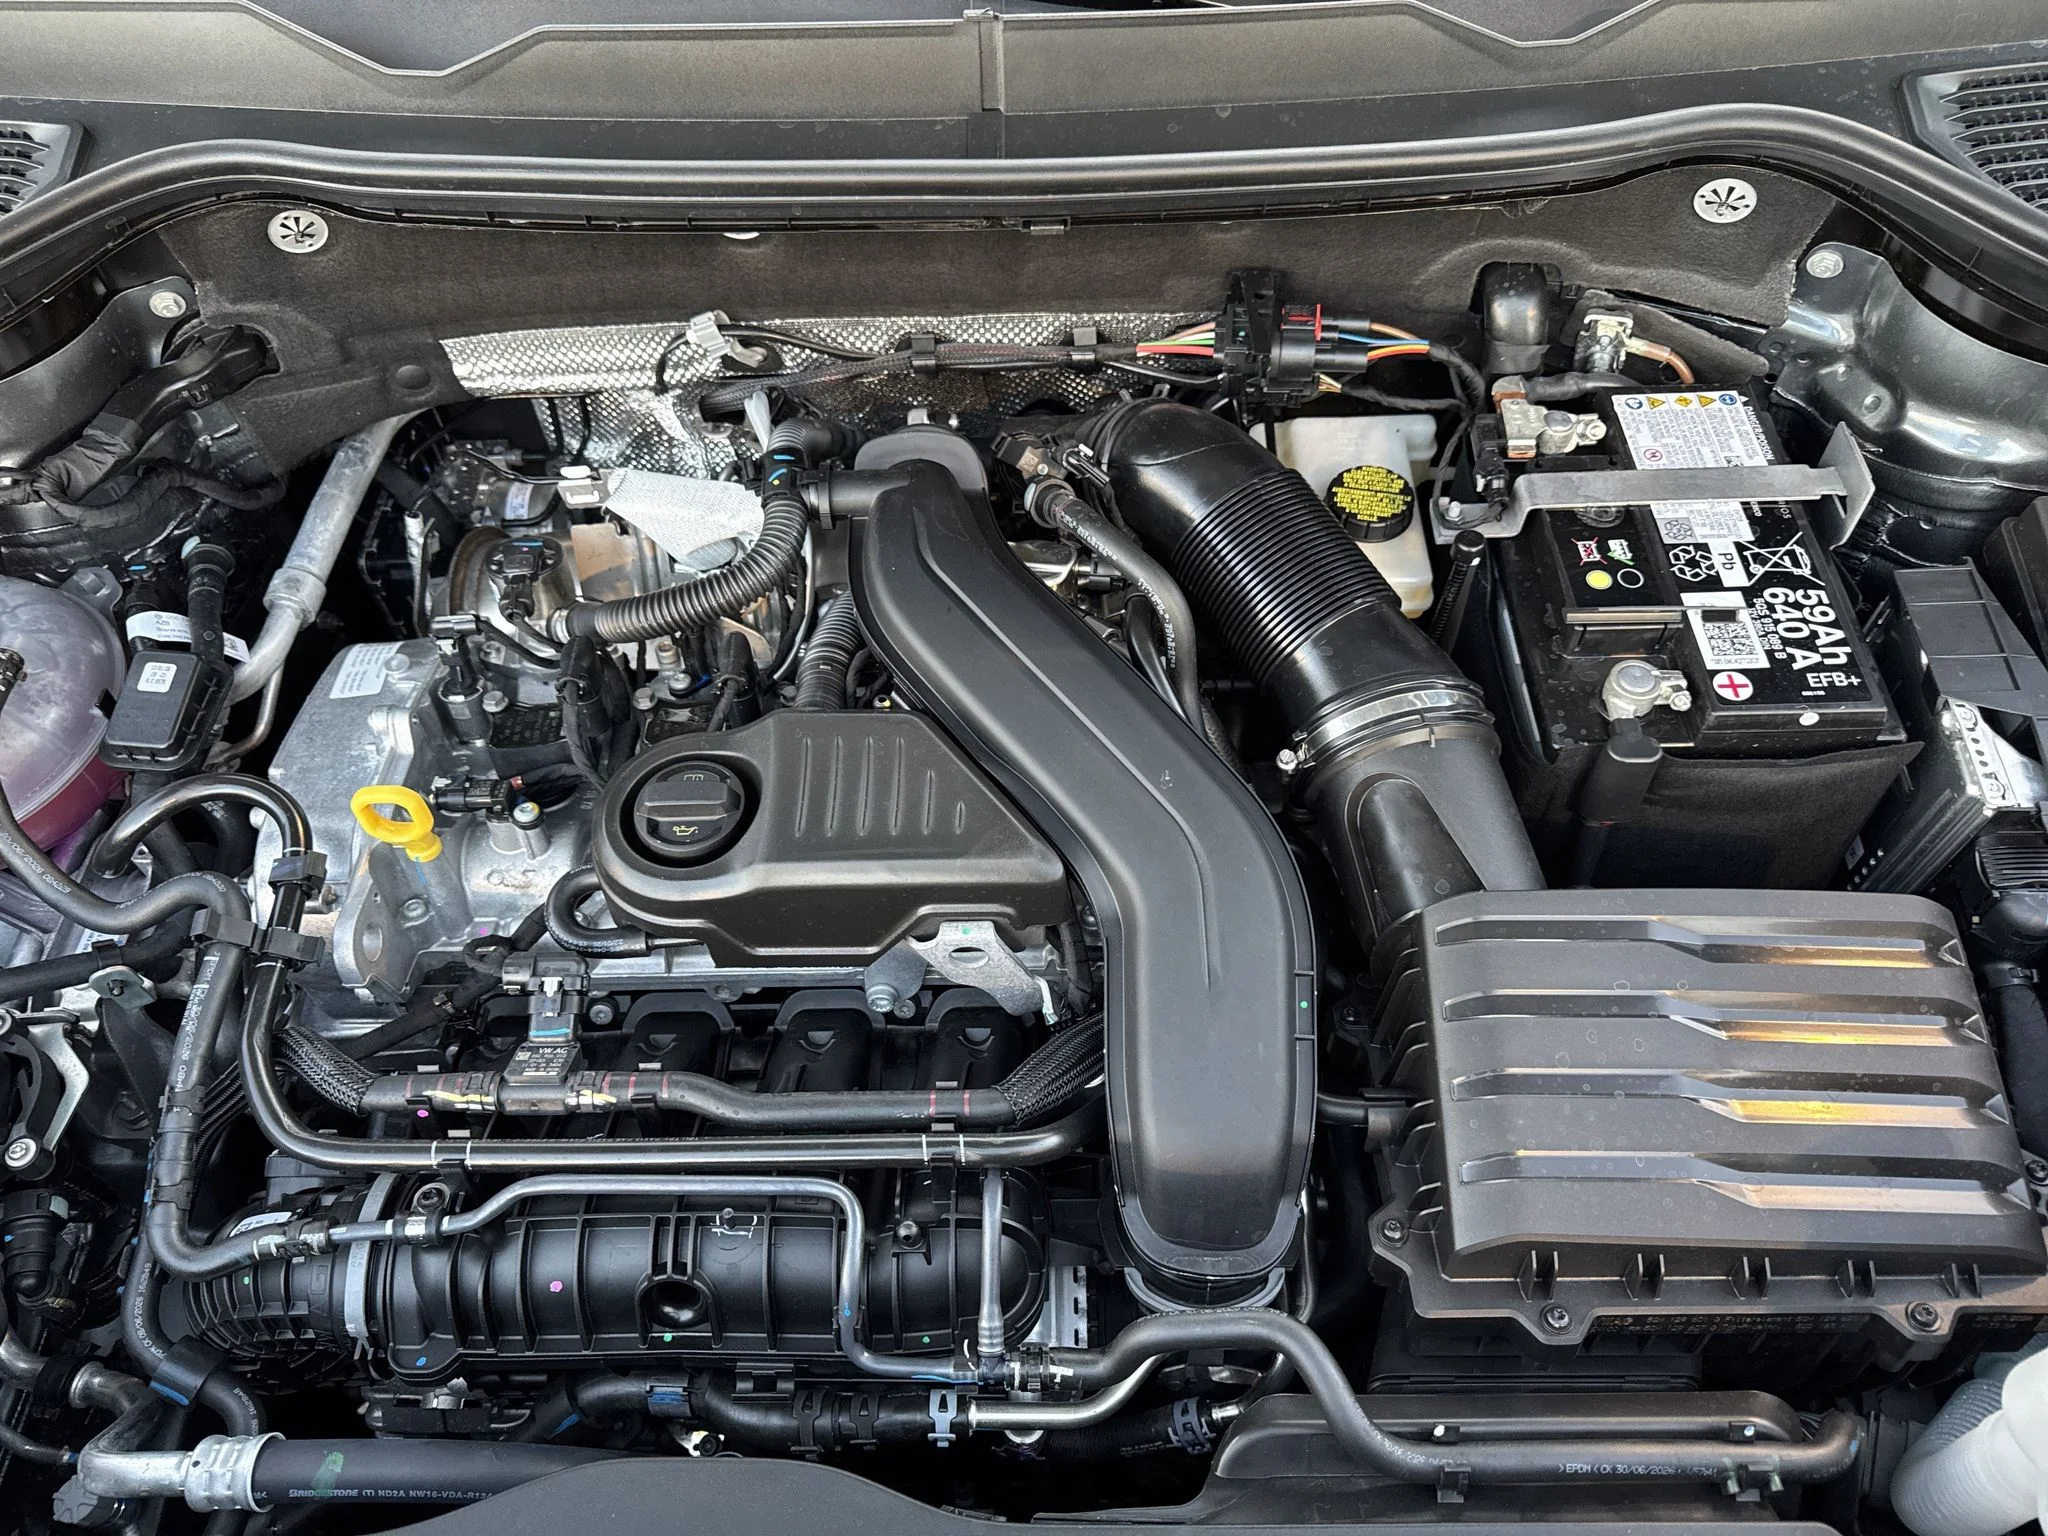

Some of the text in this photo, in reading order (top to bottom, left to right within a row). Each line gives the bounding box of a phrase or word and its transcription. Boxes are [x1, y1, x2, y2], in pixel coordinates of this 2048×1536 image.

[1718, 552, 1736, 570] Pb
[1763, 587, 1811, 639] 640
[1761, 617, 1776, 632] 915
[1795, 588, 1852, 665] 59Ah
[1784, 646, 1823, 671] A
[1806, 672, 1861, 687] EFB+
[1615, 1464, 1676, 1475] 30/06/2026
[289, 1489, 358, 1498] BRIDGESTONE
[378, 1489, 405, 1497] ND2A
